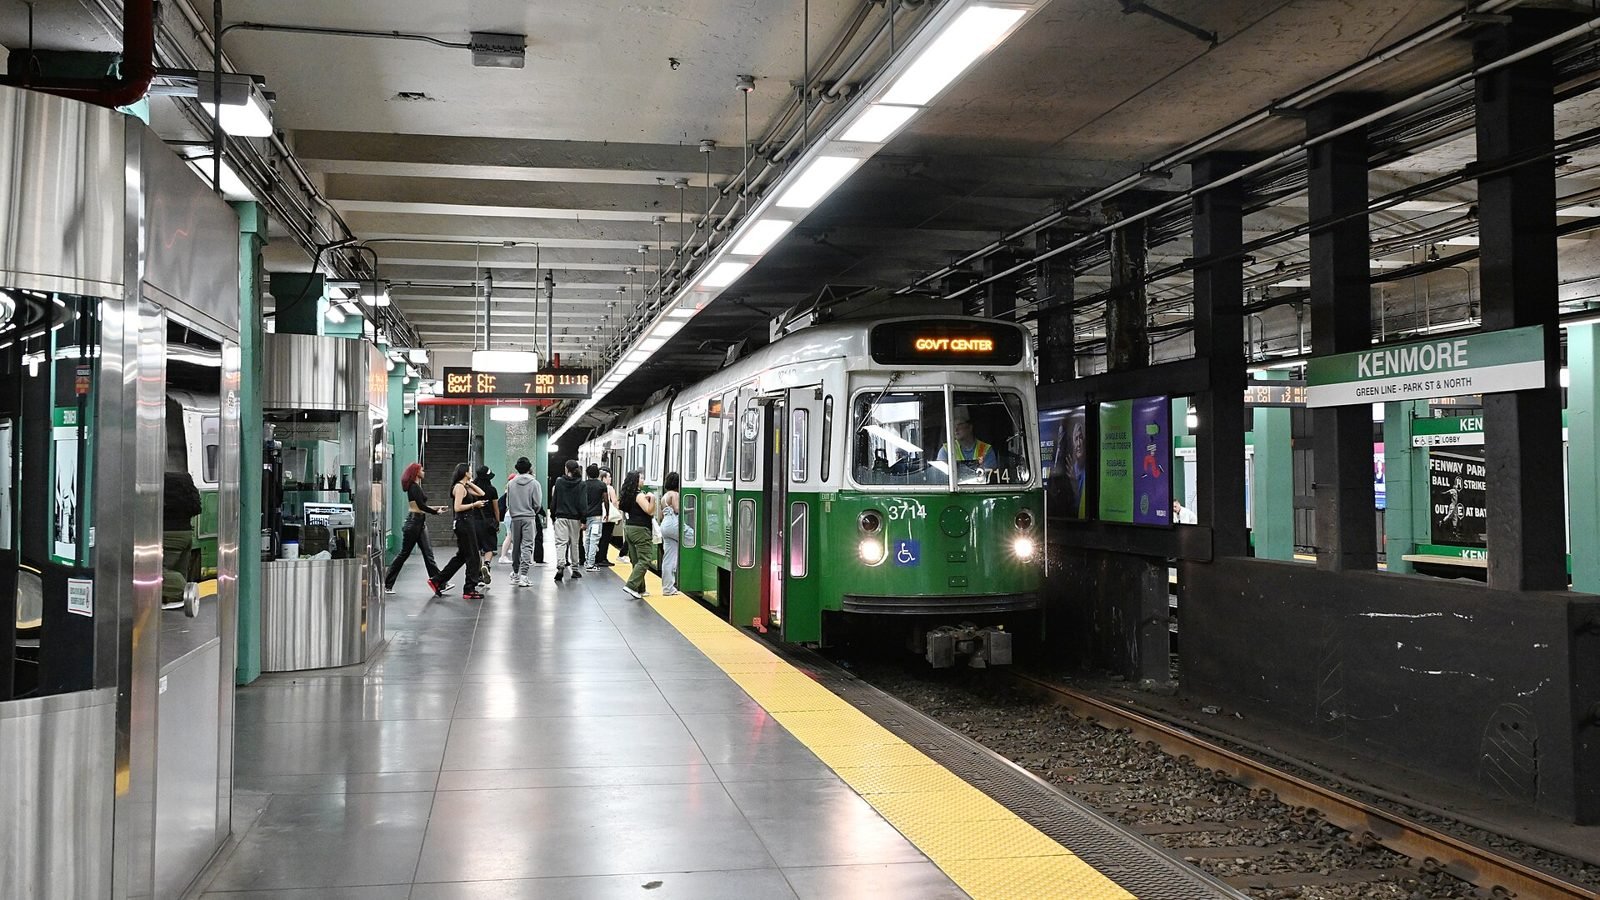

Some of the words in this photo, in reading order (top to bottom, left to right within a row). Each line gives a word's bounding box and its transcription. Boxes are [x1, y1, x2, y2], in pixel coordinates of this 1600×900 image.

[916, 339, 949, 350] GOV'T
[951, 339, 993, 351] CENTER
[1358, 340, 1468, 378] KENMORE
[448, 374, 472, 385] Govt
[477, 374, 496, 385] Ctr
[536, 375, 554, 384] BRD
[559, 375, 588, 385] 11:16
[448, 384, 472, 393] Govt
[477, 384, 496, 393] Ctr
[524, 383, 531, 393] 7
[536, 384, 554, 393] min
[1356, 387, 1379, 397] GREEN
[1381, 385, 1396, 394] LINE
[1403, 383, 1423, 392] PARK
[1425, 381, 1434, 390] ST
[1437, 380, 1442, 389] &
[1444, 378, 1472, 388] NORTH
[1281, 394, 1291, 403] 12
[1430, 459, 1463, 473] FENWAY
[975, 469, 1010, 484] 3714
[1432, 476, 1450, 487] BALL
[1464, 480, 1486, 490] STRIKE
[888, 505, 927, 520] 3714
[1435, 504, 1448, 514] OUT
[1466, 507, 1473, 517] AT
[1462, 550, 1487, 560] KEN
